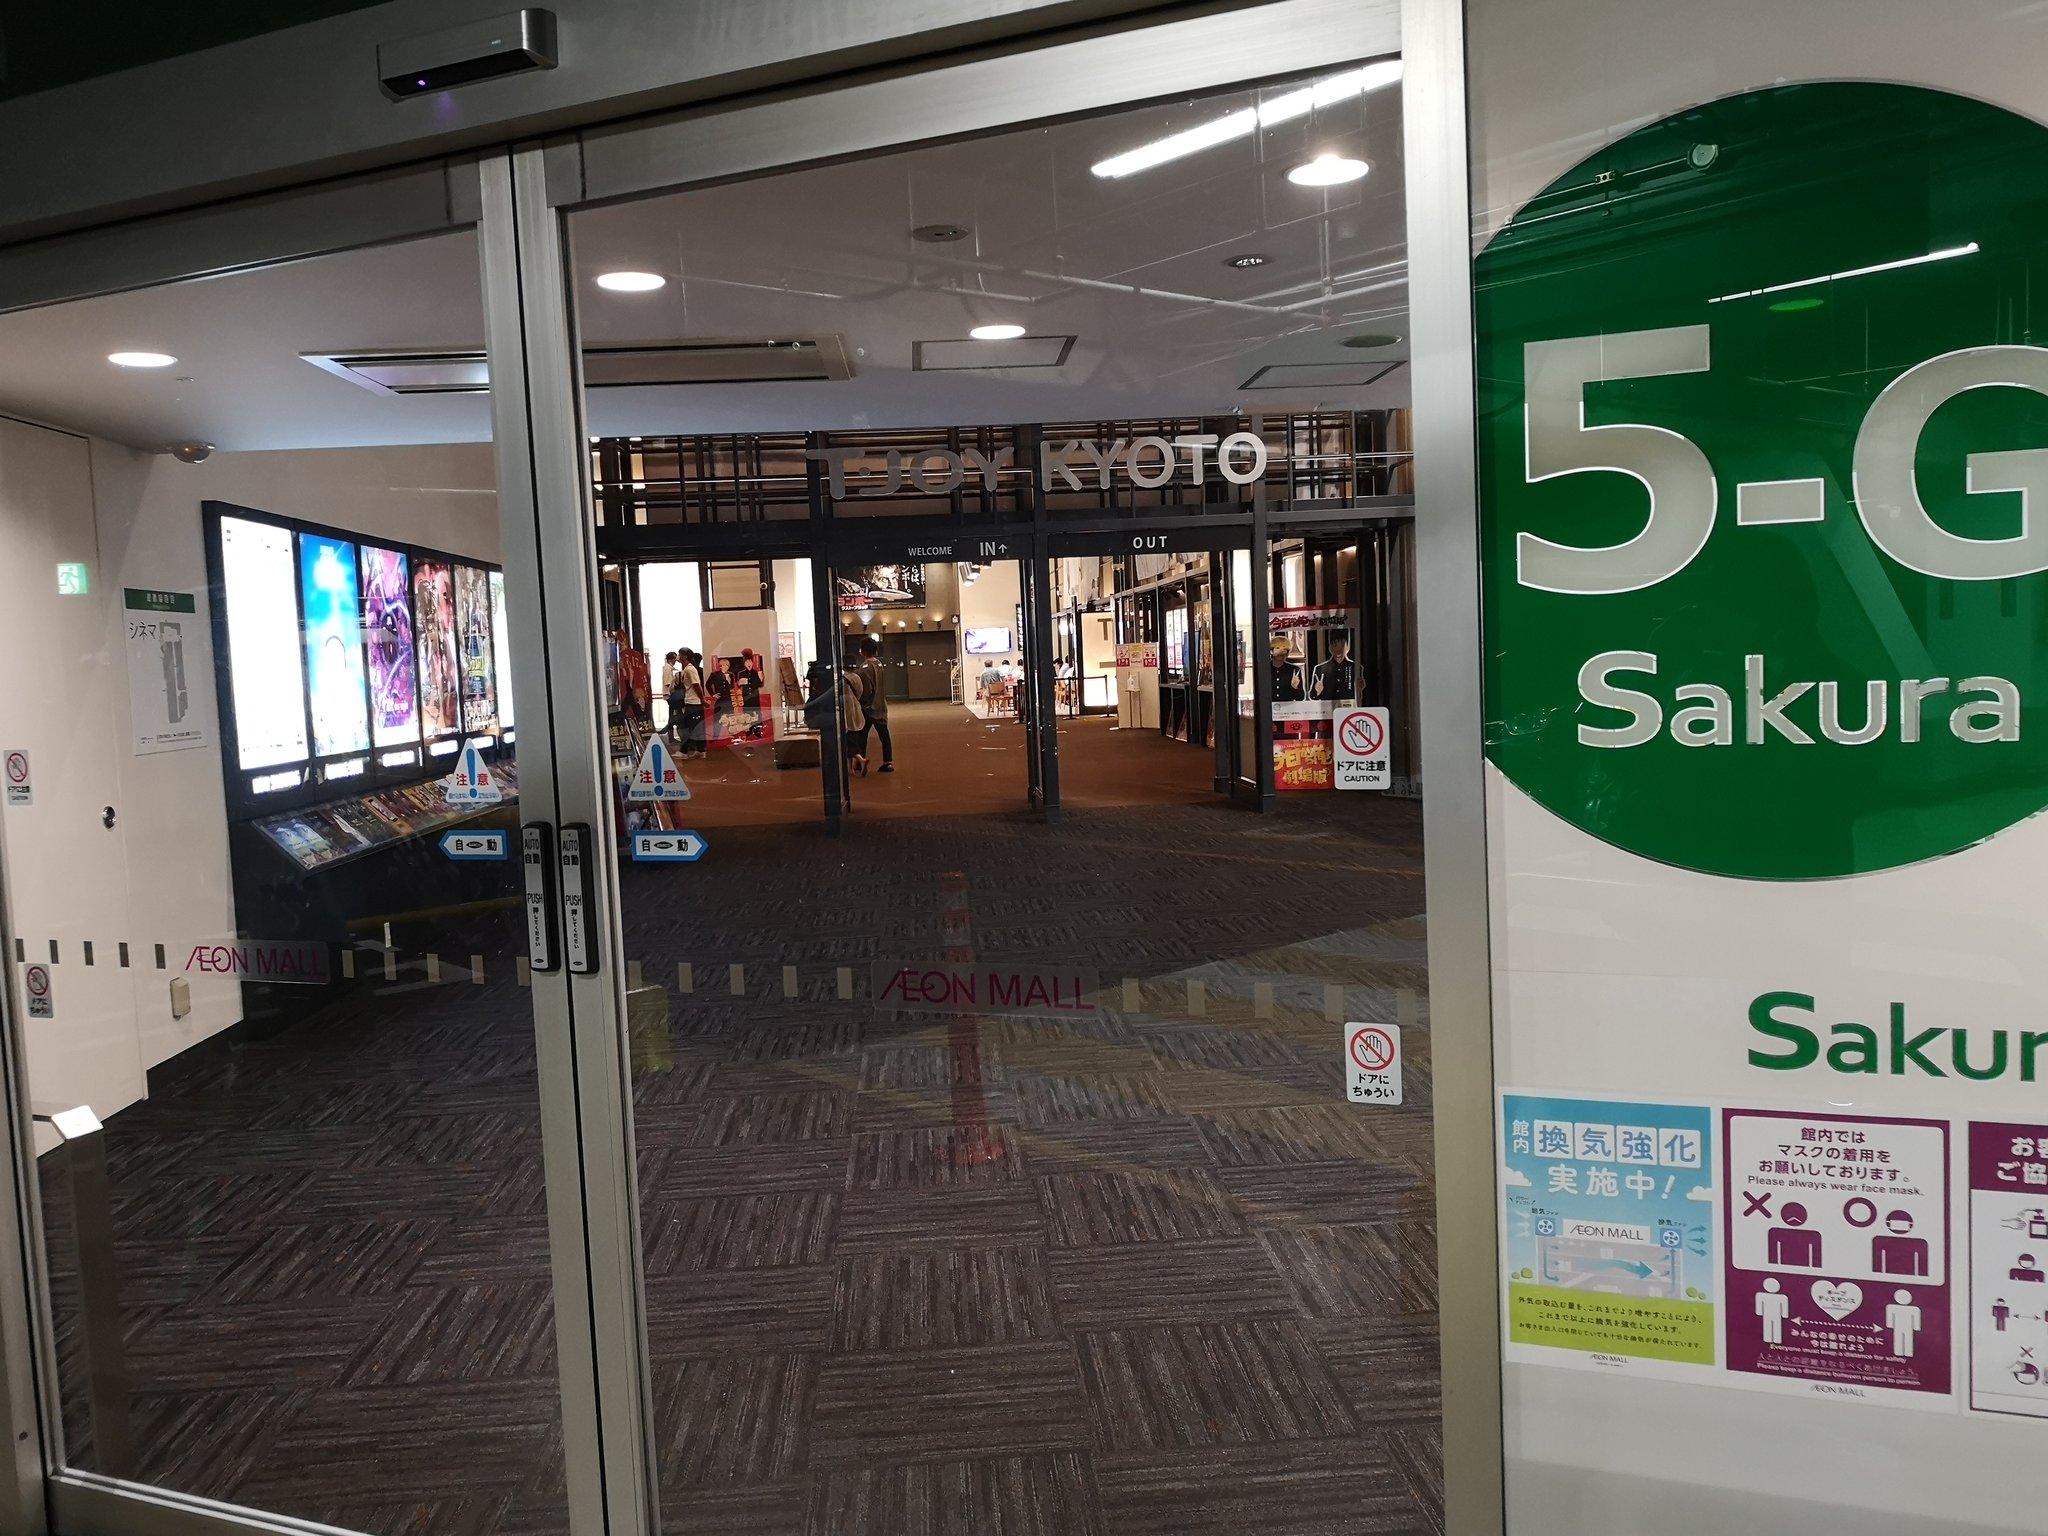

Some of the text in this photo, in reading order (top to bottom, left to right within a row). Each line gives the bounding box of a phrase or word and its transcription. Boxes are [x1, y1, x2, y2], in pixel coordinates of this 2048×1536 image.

[1039, 431, 1268, 492] KYOTO
[1517, 324, 2048, 595] 5-G
[908, 541, 996, 556] WELCOME IN
[1132, 535, 1168, 549] OUT
[129, 622, 157, 640] シネマ
[1577, 650, 2021, 748] Sakura
[1337, 760, 1387, 772] ドアに注意
[524, 838, 540, 850] AUTO
[562, 840, 579, 852] AUTO
[525, 853, 541, 864] 自動
[563, 854, 579, 866] 自動
[527, 893, 544, 905] PUSH
[565, 895, 582, 906] PUSH
[532, 906, 541, 947] 押してください
[571, 908, 580, 949] 押してください
[256, 947, 327, 976] MALL
[988, 973, 1094, 1010] MALL
[1358, 1073, 1390, 1085] ドアに
[1352, 1086, 1395, 1098] ちゅうい
[1512, 1119, 1530, 1154] 館内
[1538, 1124, 1696, 1163] 換気強化
[1800, 1127, 1866, 1144] 館内では
[1778, 1144, 1891, 1164] マスクの着用を
[1759, 1160, 1911, 1183] お願いしております。
[1547, 1163, 1676, 1201] 実施中!
[1747, 1175, 1925, 1197] Please always wear face mask.
[1607, 1227, 1644, 1241] MALL
